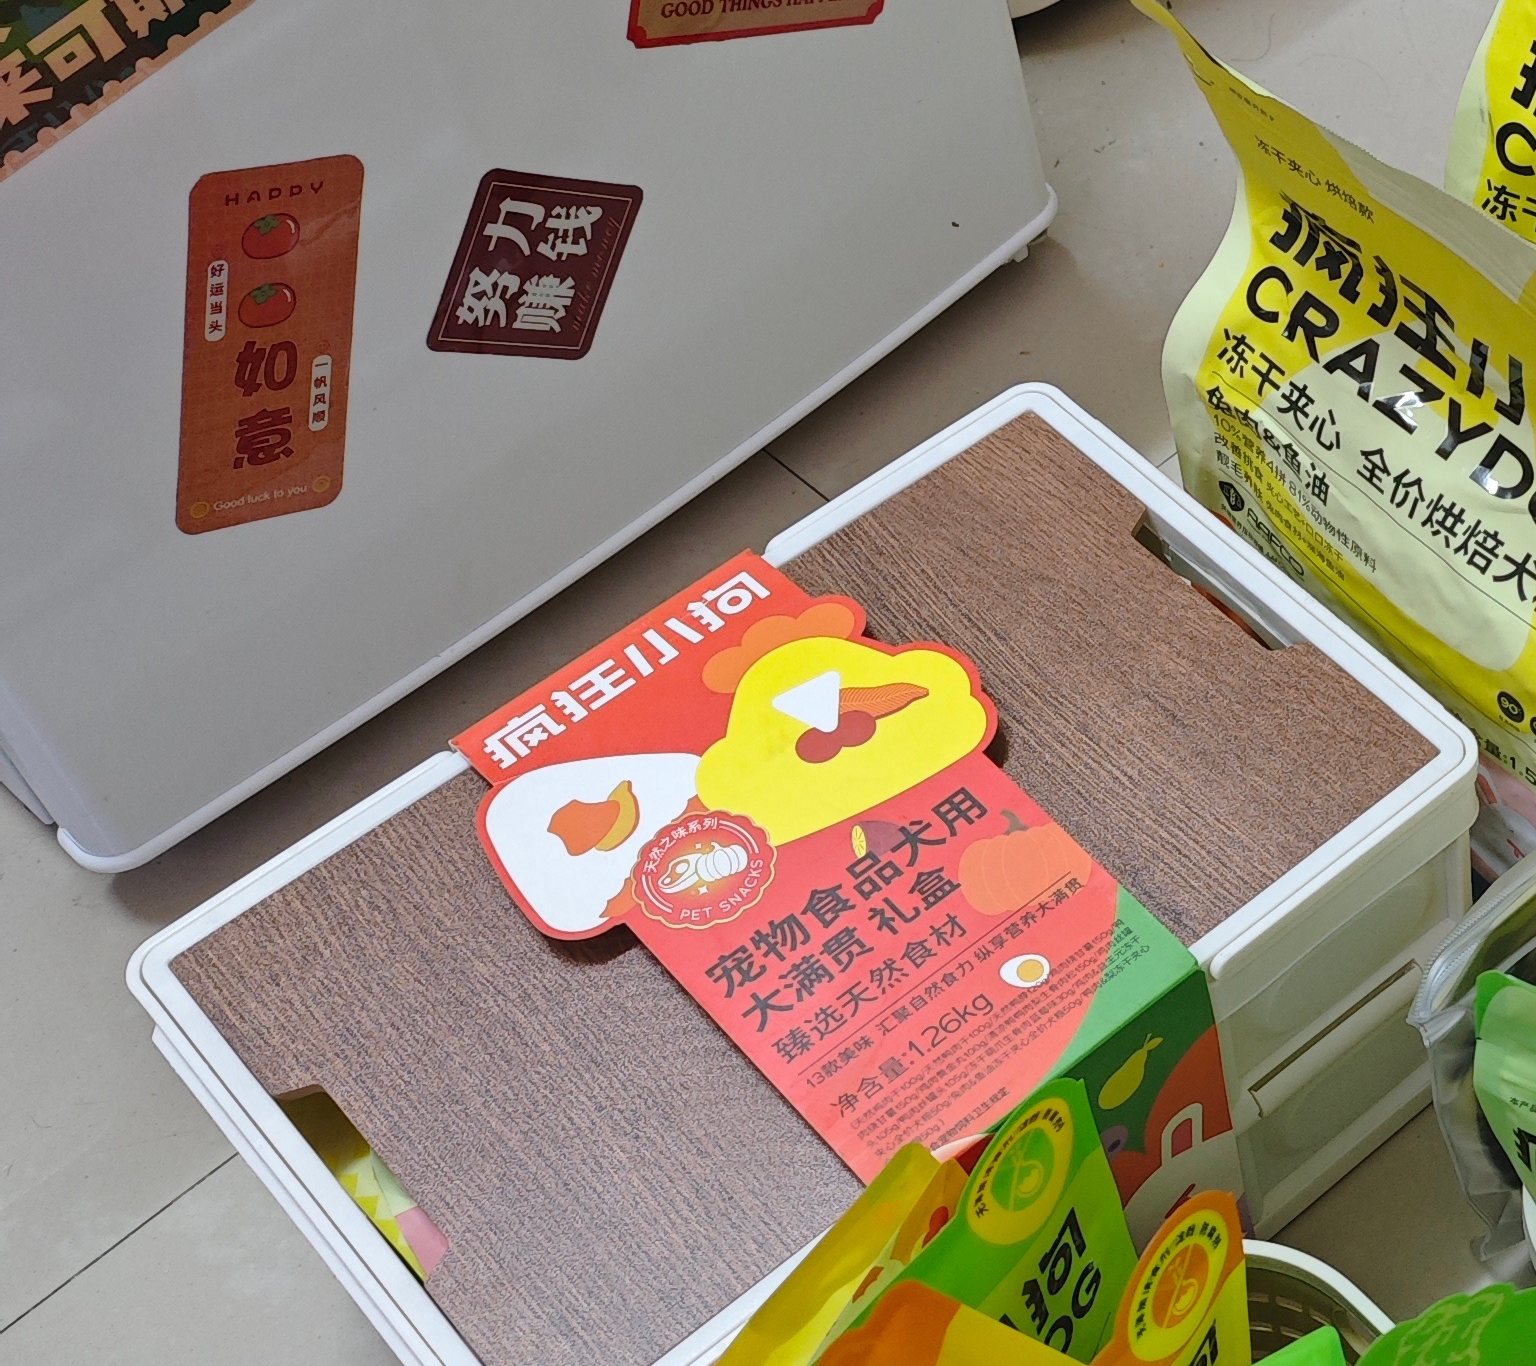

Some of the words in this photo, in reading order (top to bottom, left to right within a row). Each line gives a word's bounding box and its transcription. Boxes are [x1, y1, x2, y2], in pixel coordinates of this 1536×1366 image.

[660, 0, 714, 19] GOOD
[224, 180, 324, 207] HAPPY
[1254, 134, 1322, 187] 冻干夹心
[208, 262, 225, 334] 好运当头
[455, 196, 545, 328] 努力
[232, 338, 298, 471] 如意
[312, 360, 329, 425] 一帆风顺
[1206, 385, 1330, 507] 兔肉&鱼油
[1216, 328, 1341, 453] 冻干夹心
[213, 495, 245, 513] Good
[247, 489, 270, 505] luck
[272, 488, 286, 499] to
[287, 484, 307, 498] you
[482, 571, 771, 770] 疯狂小狗
[643, 817, 719, 874] 天然之味系列
[679, 906, 712, 922] PET
[720, 858, 764, 913] SNACKS
[704, 785, 989, 1001] 宠物食品犬用
[741, 926, 874, 1034] 大满贯
[867, 864, 963, 937] 礼盒
[770, 912, 969, 1064] 臻选天然食材
[805, 1035, 874, 1089] 13款美味
[876, 962, 975, 1035] 汇聚自然食力
[974, 877, 1086, 965] 纵享营养大满贯
[830, 991, 995, 1118] 净含量:1.26kg
